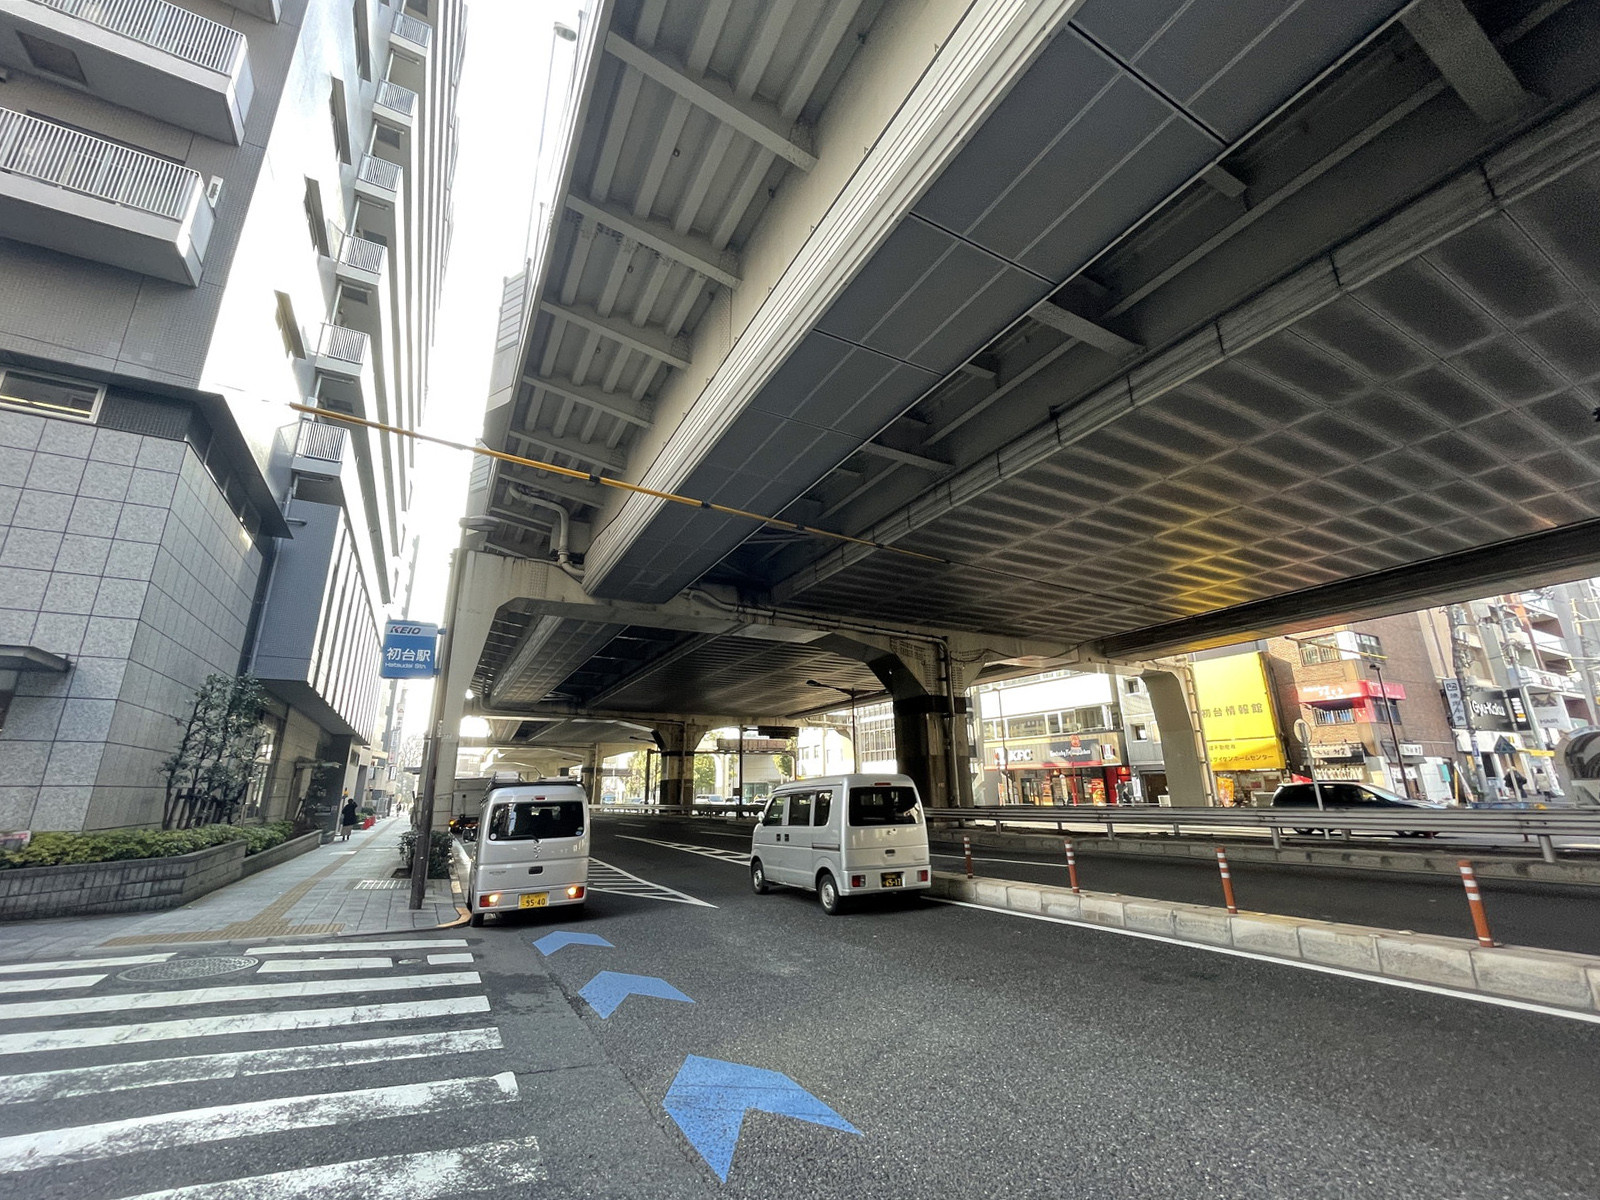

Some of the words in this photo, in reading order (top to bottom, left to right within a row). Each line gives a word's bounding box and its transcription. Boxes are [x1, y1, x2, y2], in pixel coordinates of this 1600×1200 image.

[390, 625, 421, 635] KEIO
[386, 648, 431, 661] 初台駅
[1008, 749, 1032, 761] KFC
